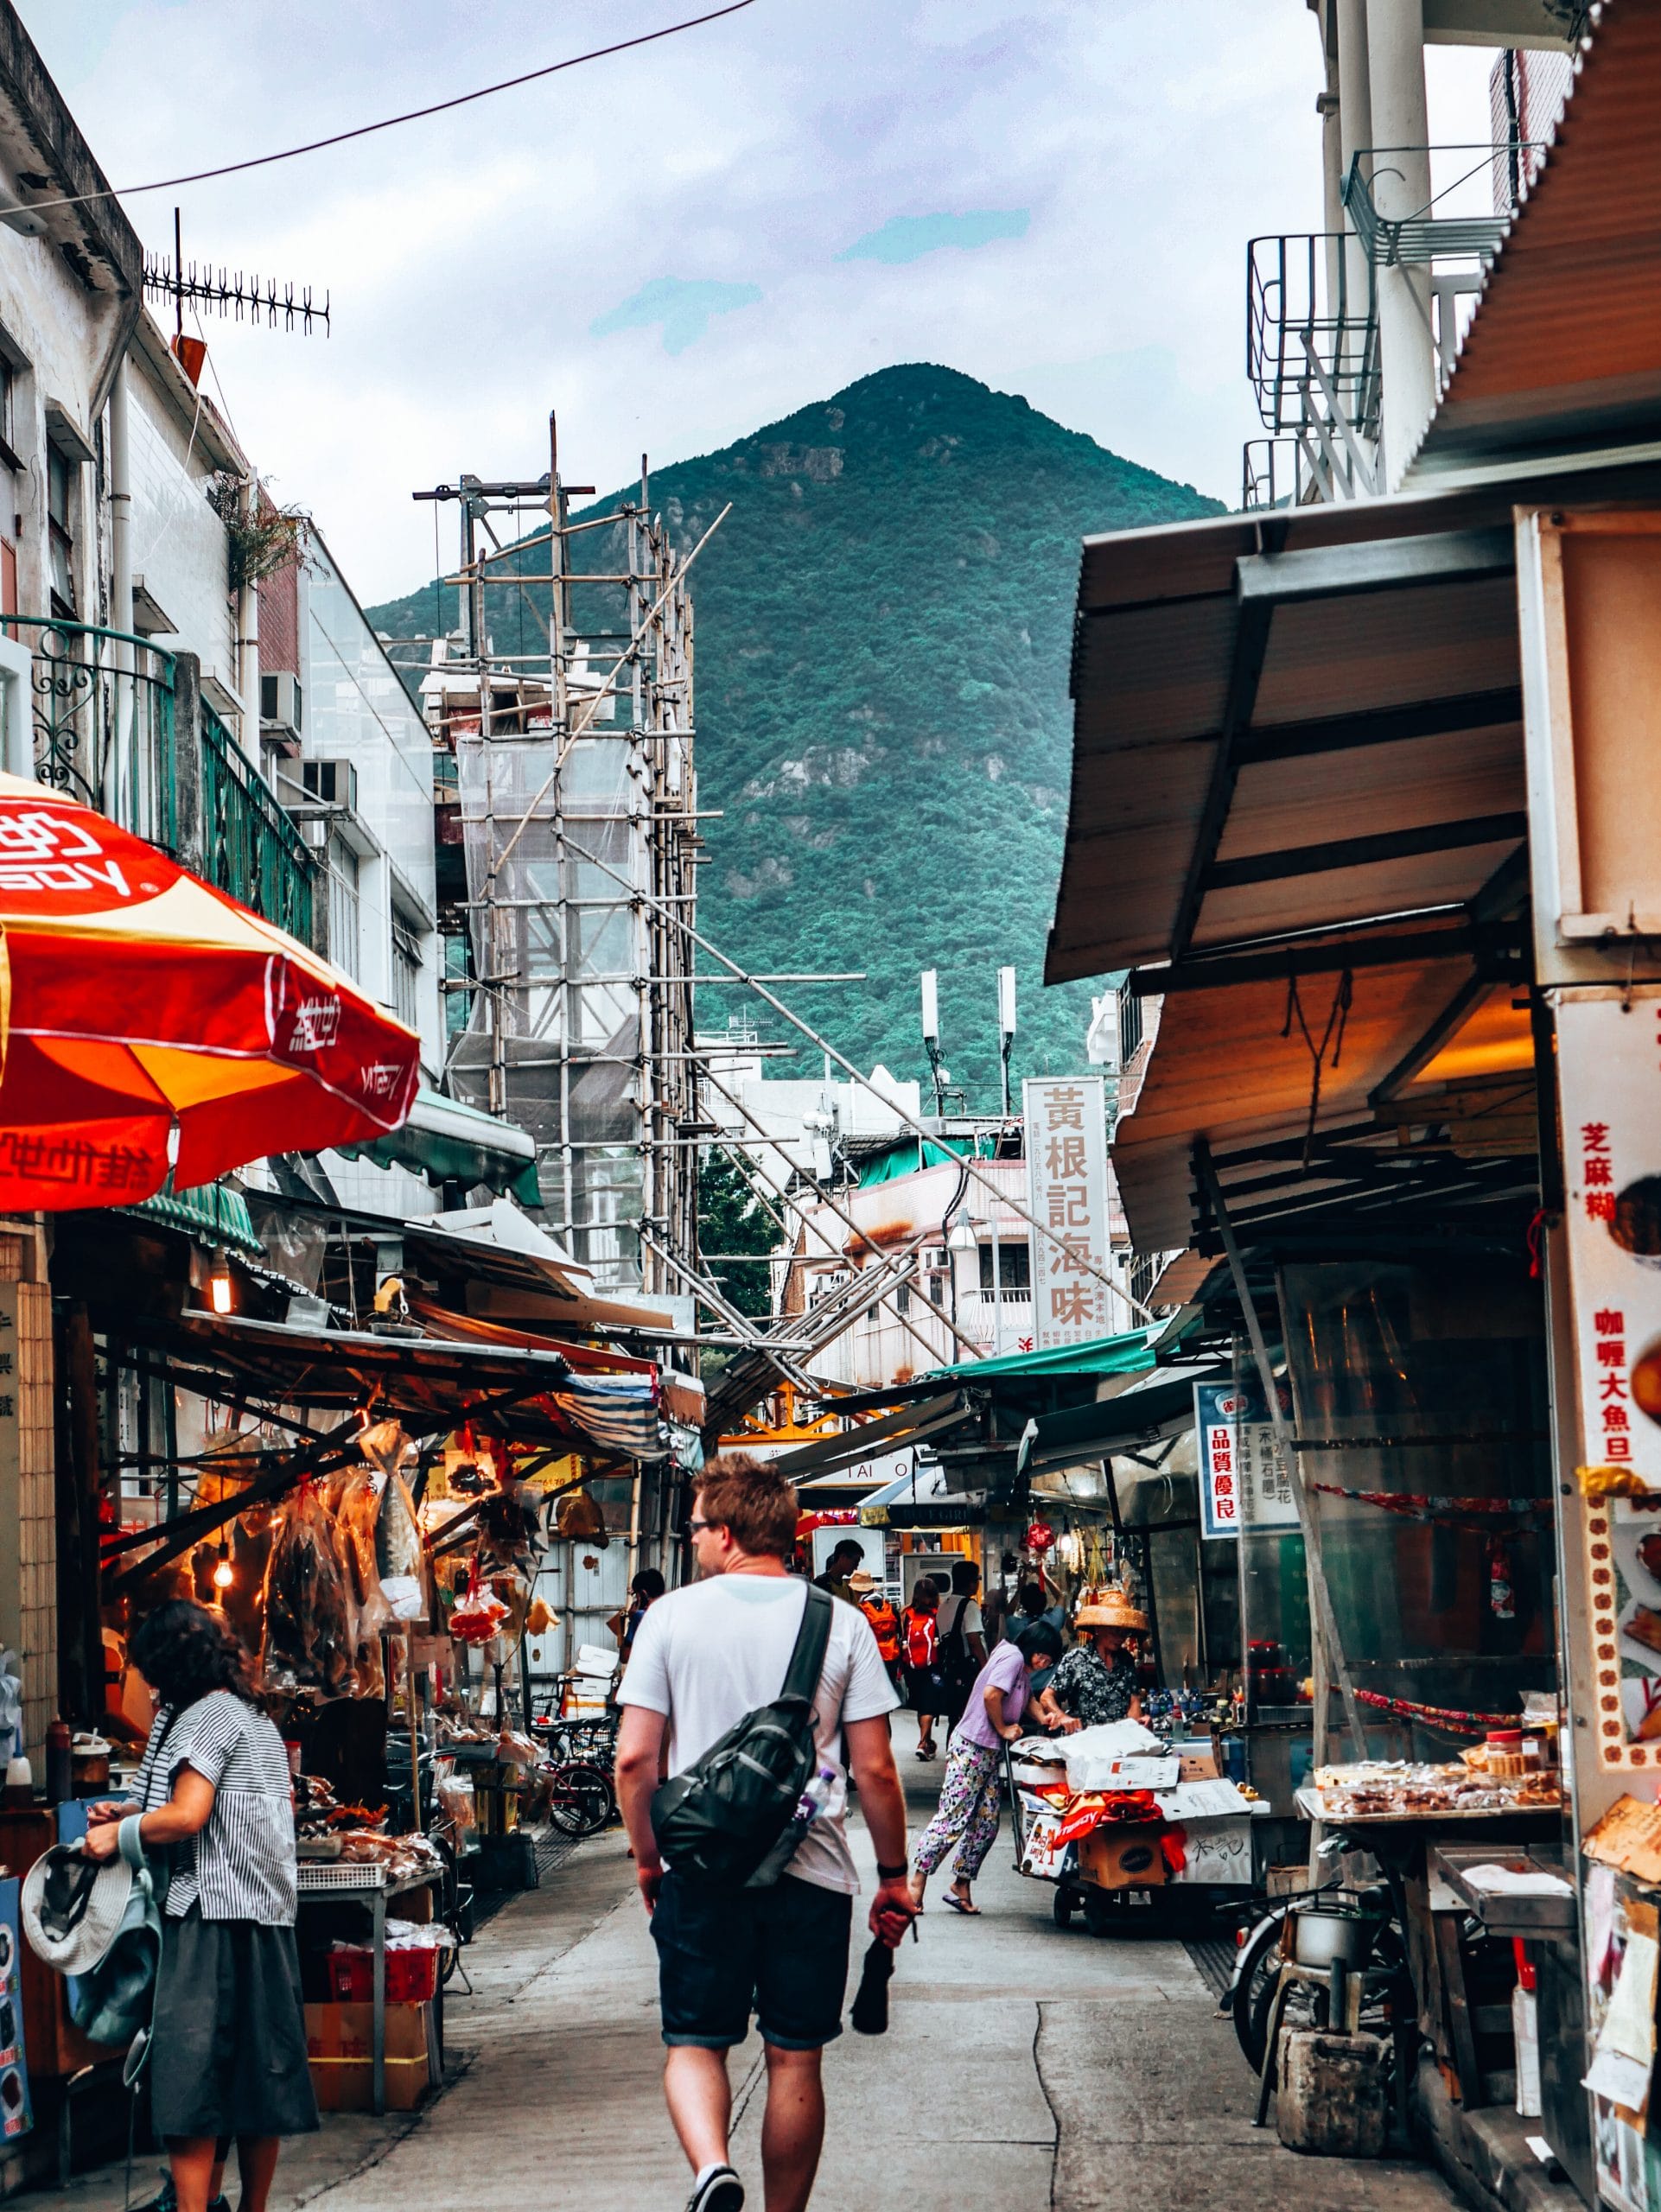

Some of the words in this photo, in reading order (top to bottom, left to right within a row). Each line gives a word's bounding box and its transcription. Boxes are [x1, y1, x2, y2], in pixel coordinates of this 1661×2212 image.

[1581, 1122, 1616, 1221] 芝麻糊
[1094, 1255, 1105, 1325] 專大澳本地
[1594, 1308, 1632, 1463] 咖喱大魚旦
[894, 1463, 907, 1477] O
[1212, 1428, 1236, 1519] 品質優良
